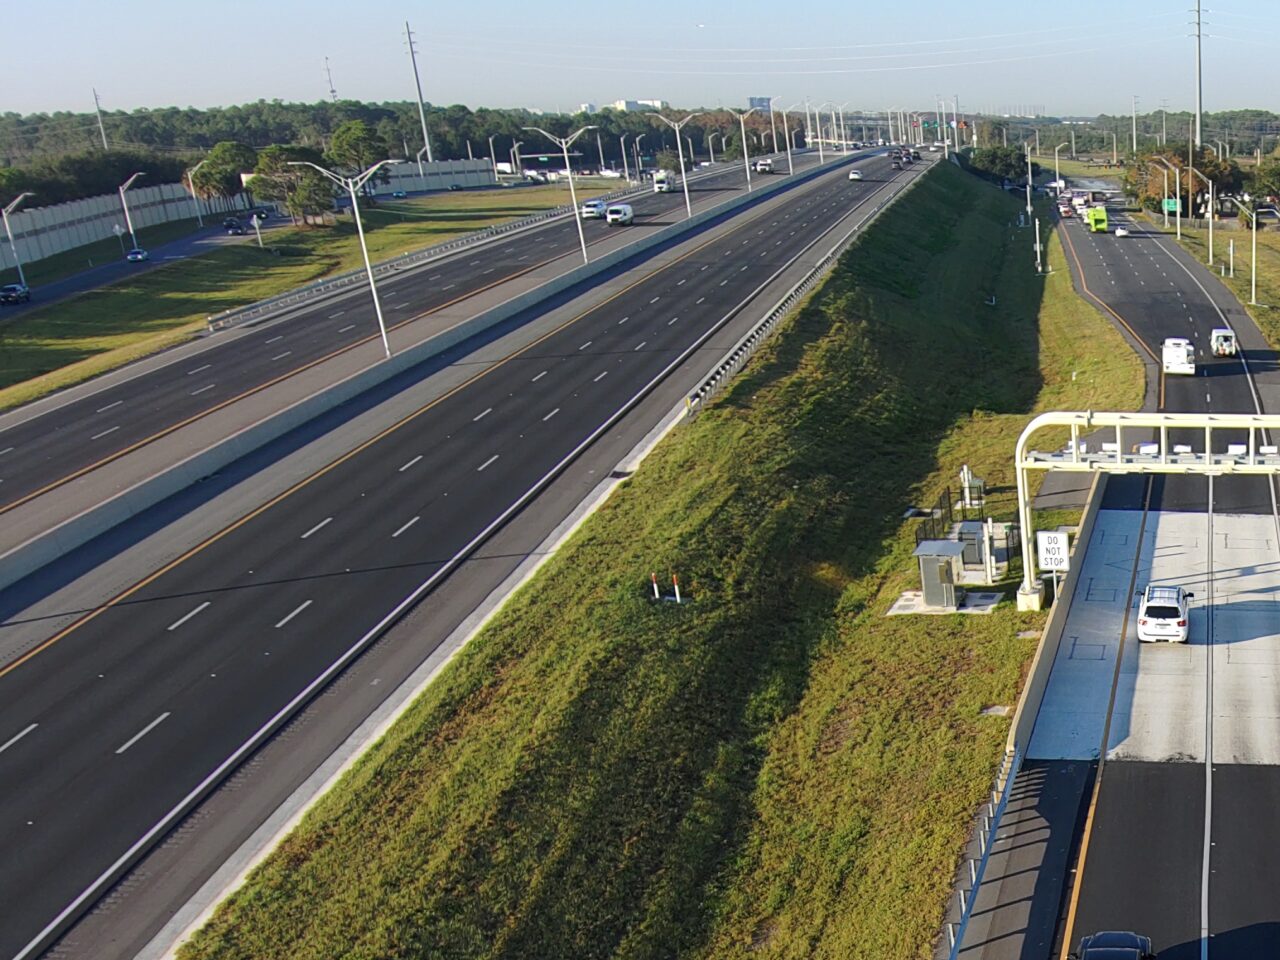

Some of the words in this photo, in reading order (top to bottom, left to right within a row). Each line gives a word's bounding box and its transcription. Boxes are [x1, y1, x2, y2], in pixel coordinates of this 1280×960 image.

[1047, 536, 1058, 545] DO
[1045, 546, 1061, 555] NOT
[1044, 557, 1064, 566] STOP
